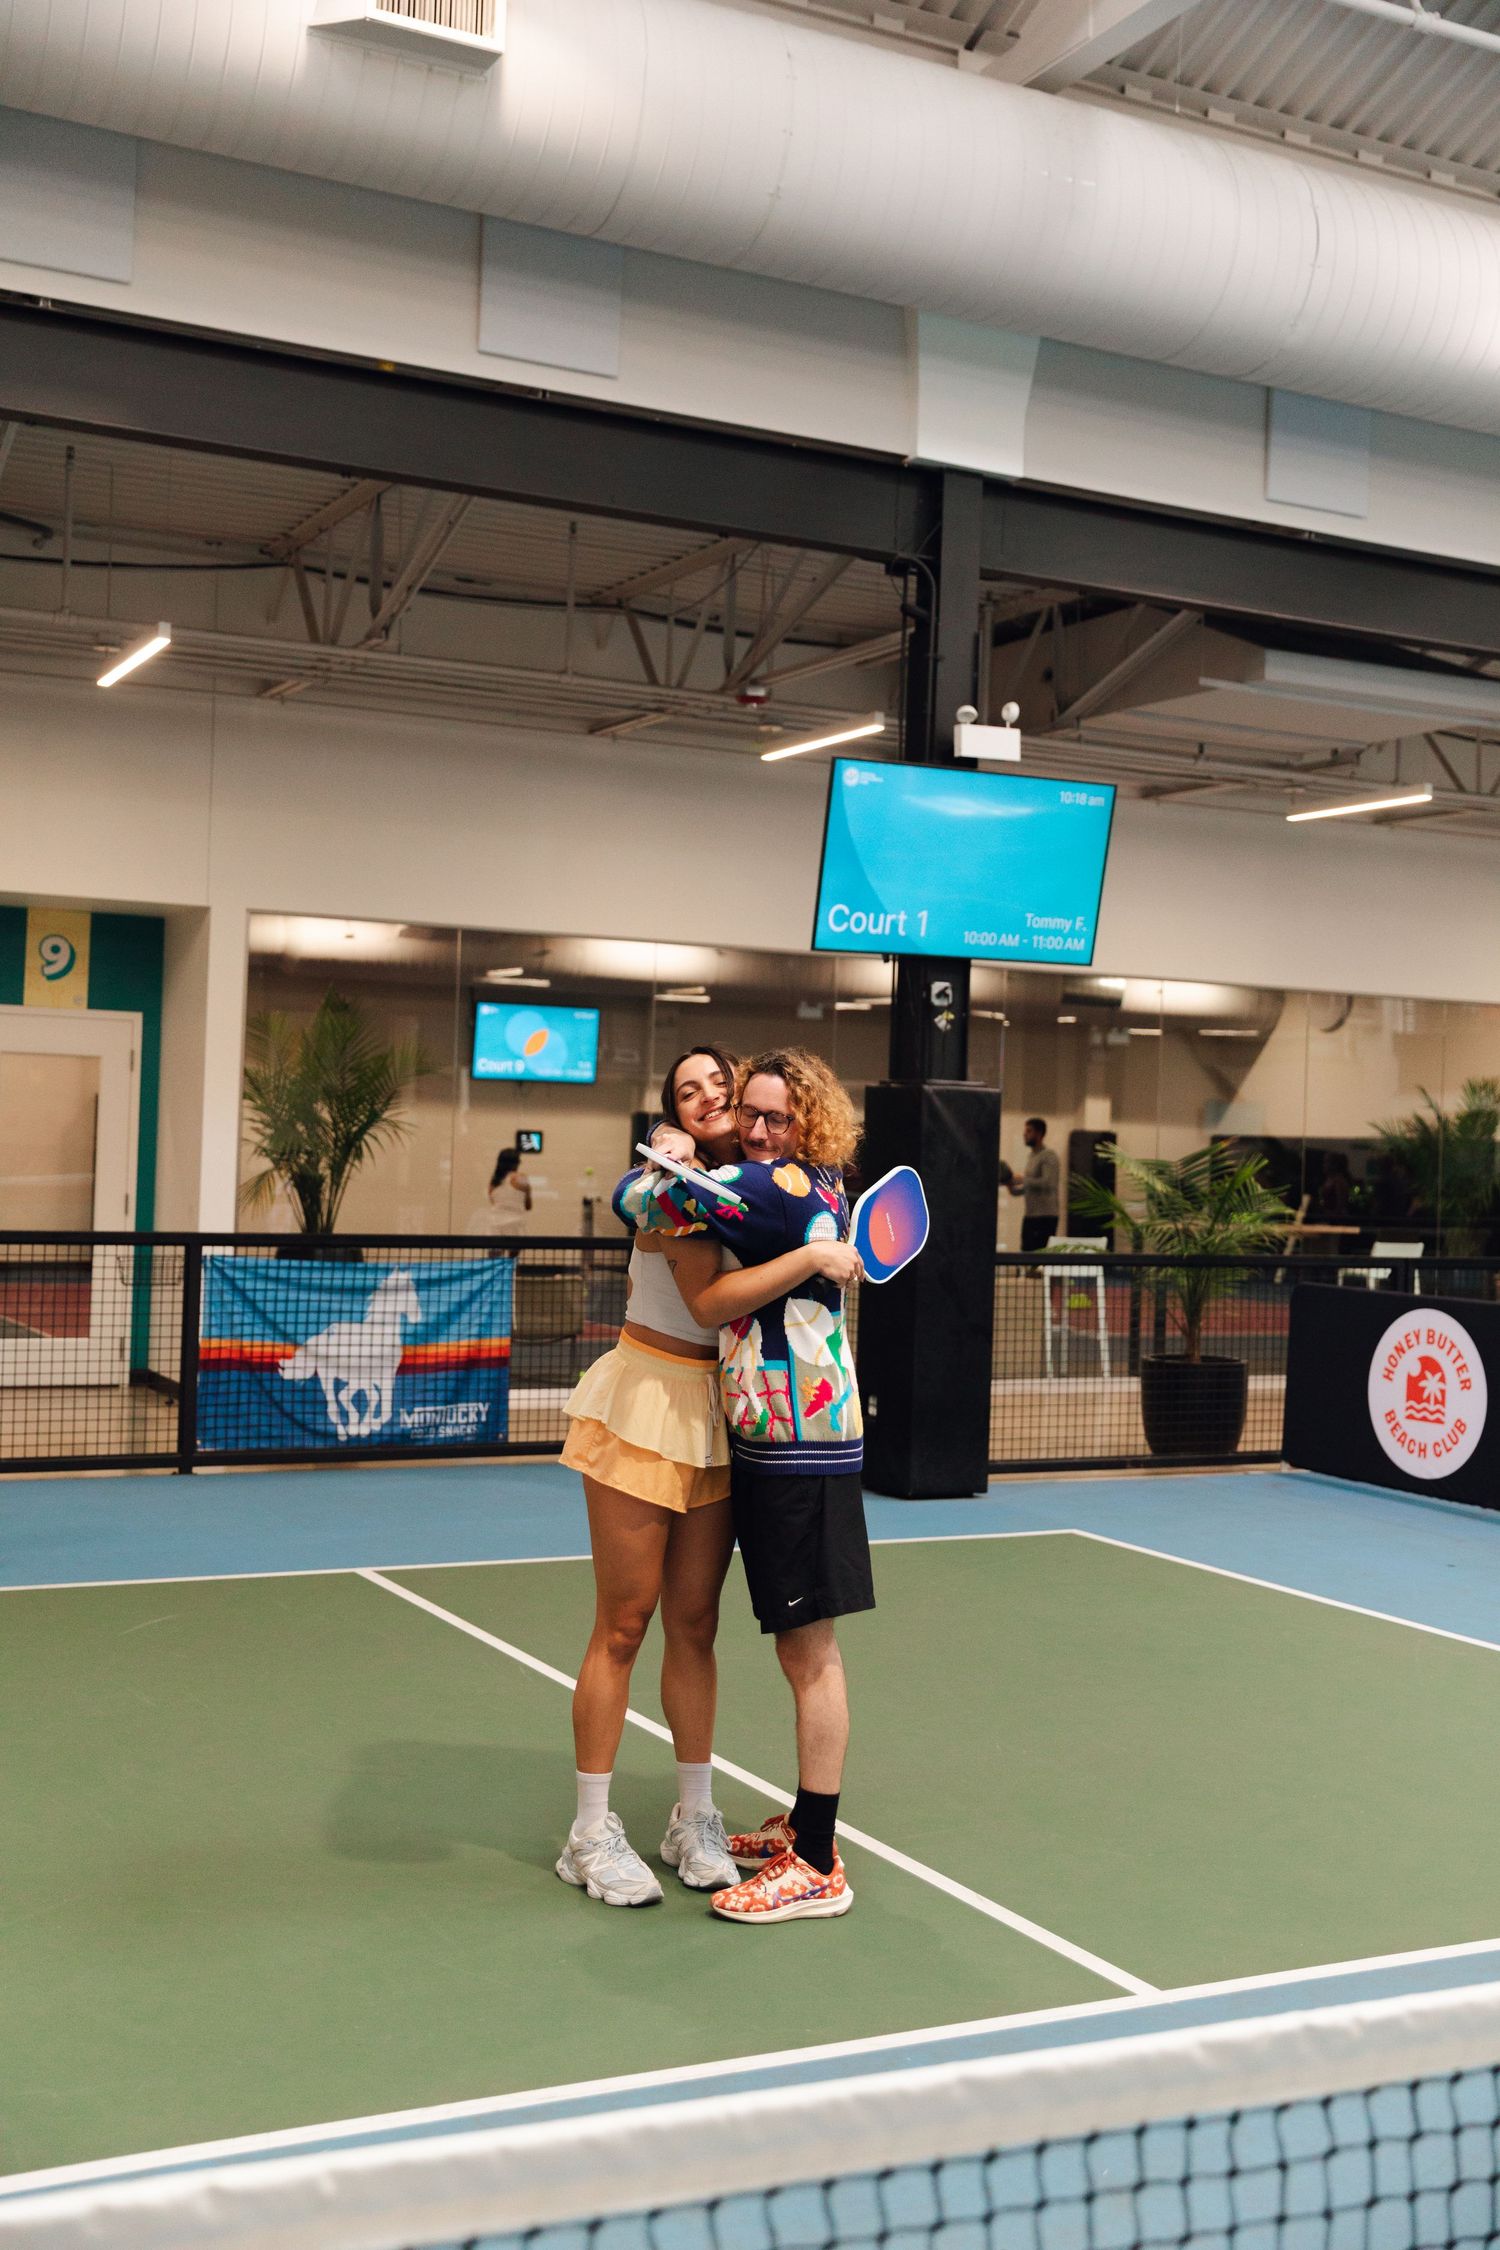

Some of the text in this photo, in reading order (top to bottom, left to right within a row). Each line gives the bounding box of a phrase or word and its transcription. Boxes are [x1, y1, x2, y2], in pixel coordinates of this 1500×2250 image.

[1088, 796, 1105, 807] am
[828, 903, 929, 937] Court 1
[1025, 912, 1088, 934] Tommy F.
[39, 934, 76, 981] 9
[963, 931, 998, 946] 10:00
[999, 933, 1020, 947] AM
[1032, 935, 1063, 950] 11:00
[1064, 937, 1086, 951] AM
[1382, 1328, 1472, 1391] HONEY BUTTER
[1384, 1409, 1468, 1459] BEACH CLUB
